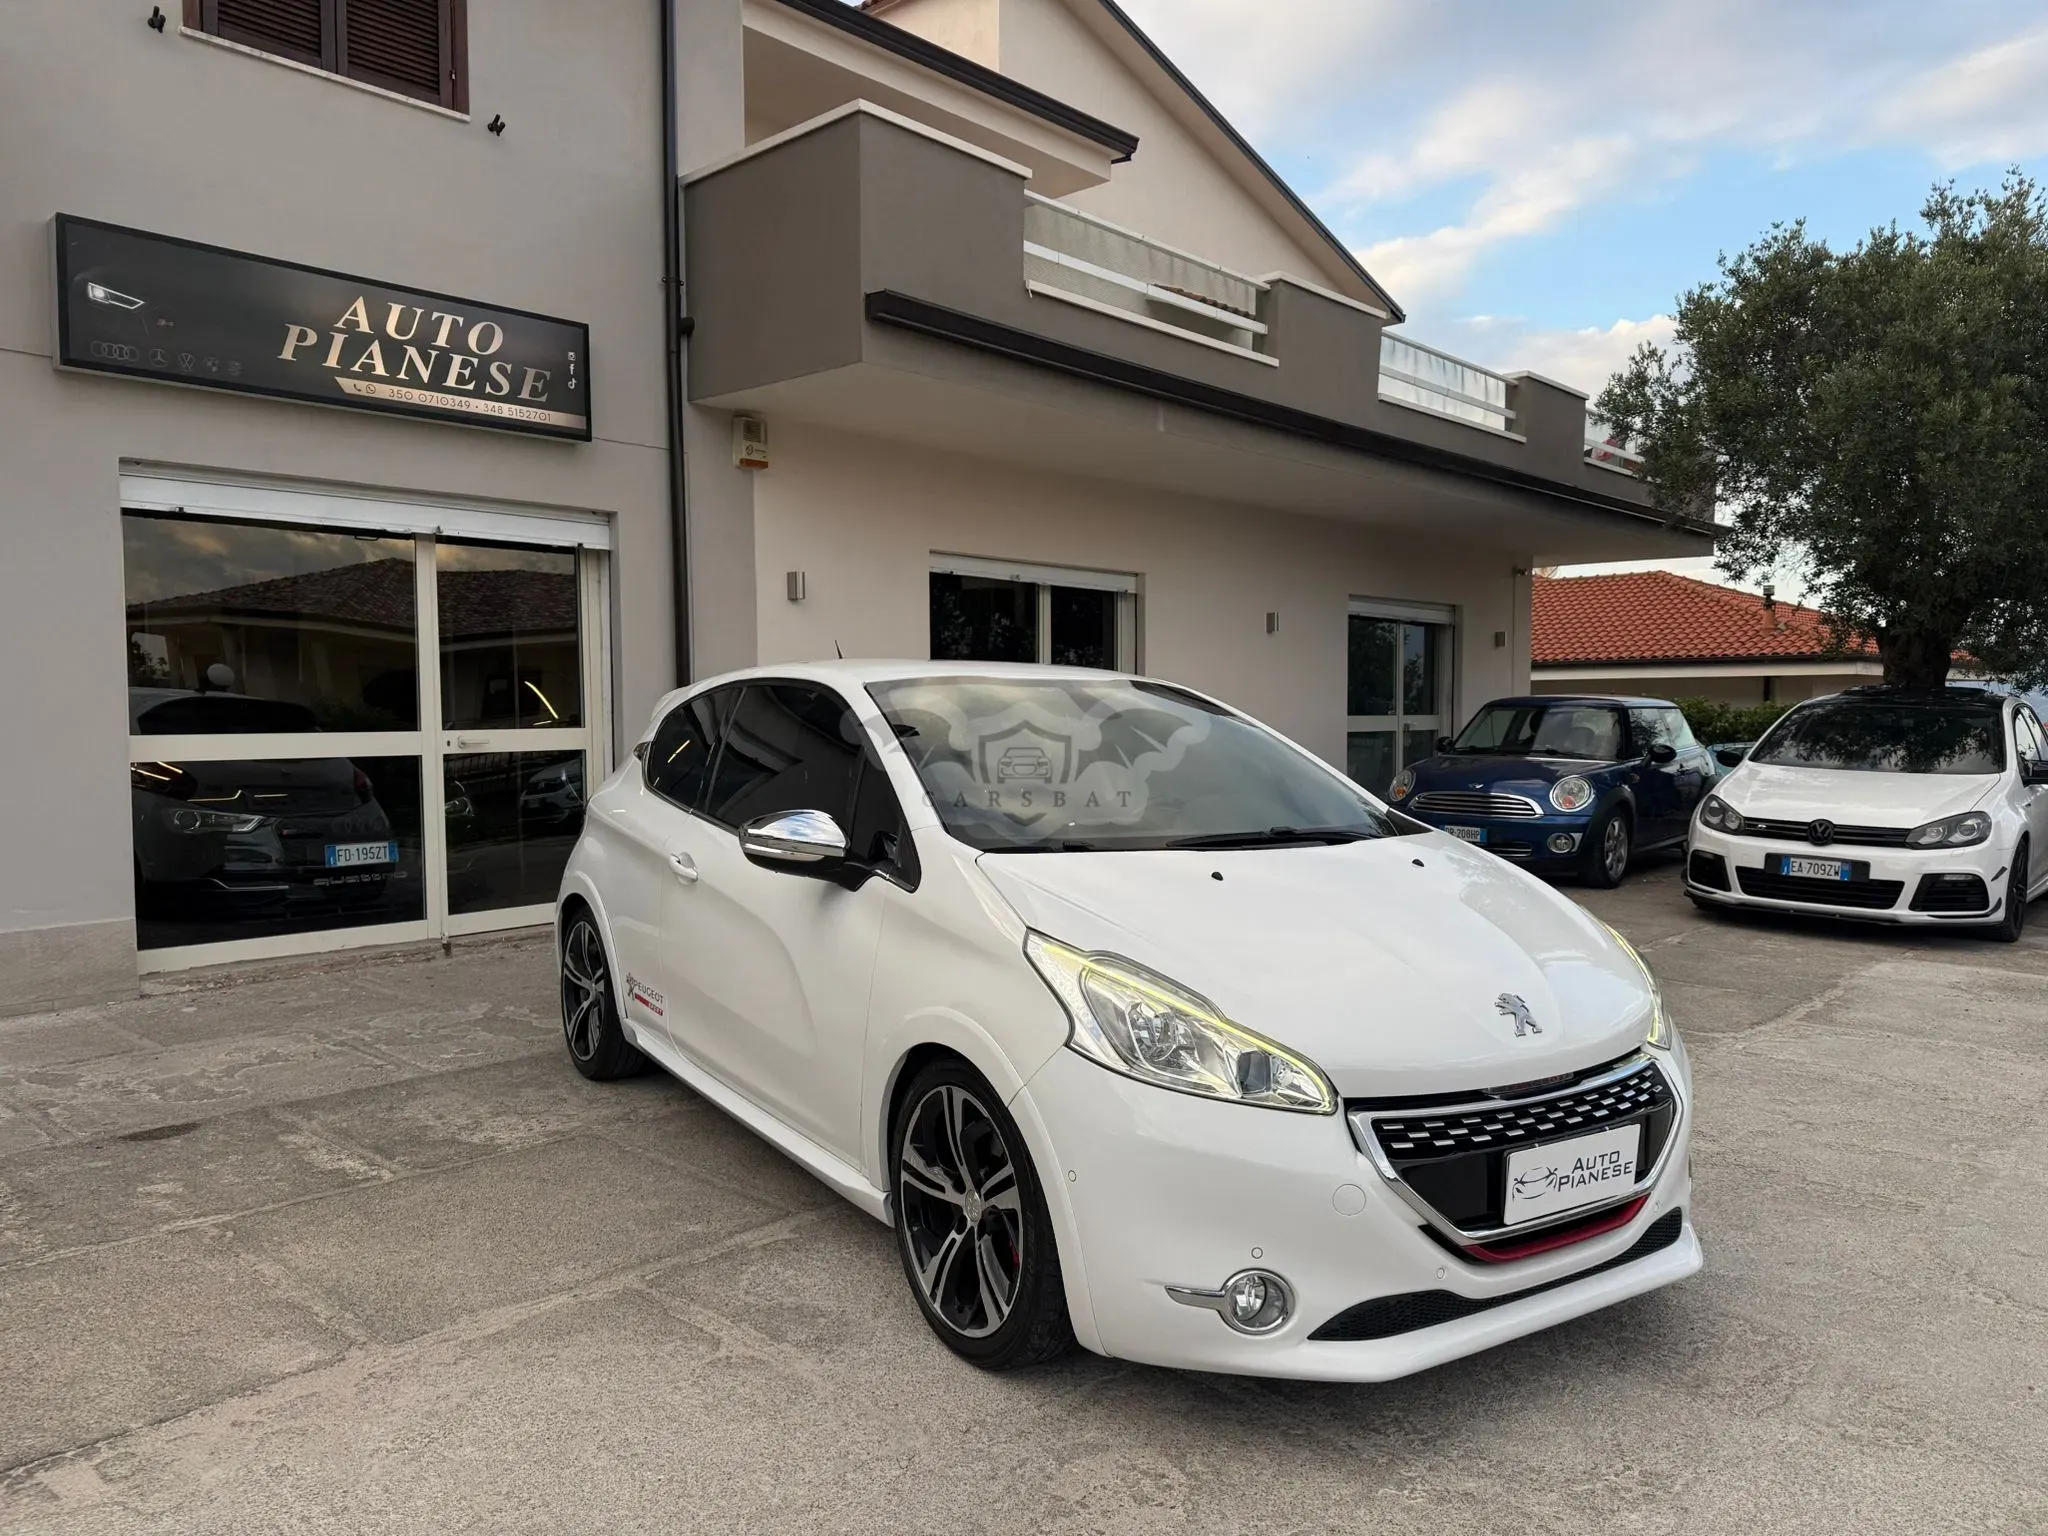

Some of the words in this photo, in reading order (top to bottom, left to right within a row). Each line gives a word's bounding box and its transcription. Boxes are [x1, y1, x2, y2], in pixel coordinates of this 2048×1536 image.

[334, 296, 504, 355] AUTO
[277, 323, 551, 402] PIANESE
[388, 388, 413, 401] 350
[418, 392, 471, 409] 0710349
[483, 403, 504, 415] 348
[507, 407, 551, 422] 5152701
[1558, 1161, 1633, 1192] PIANESE
[1571, 1150, 1620, 1174] AUTO
